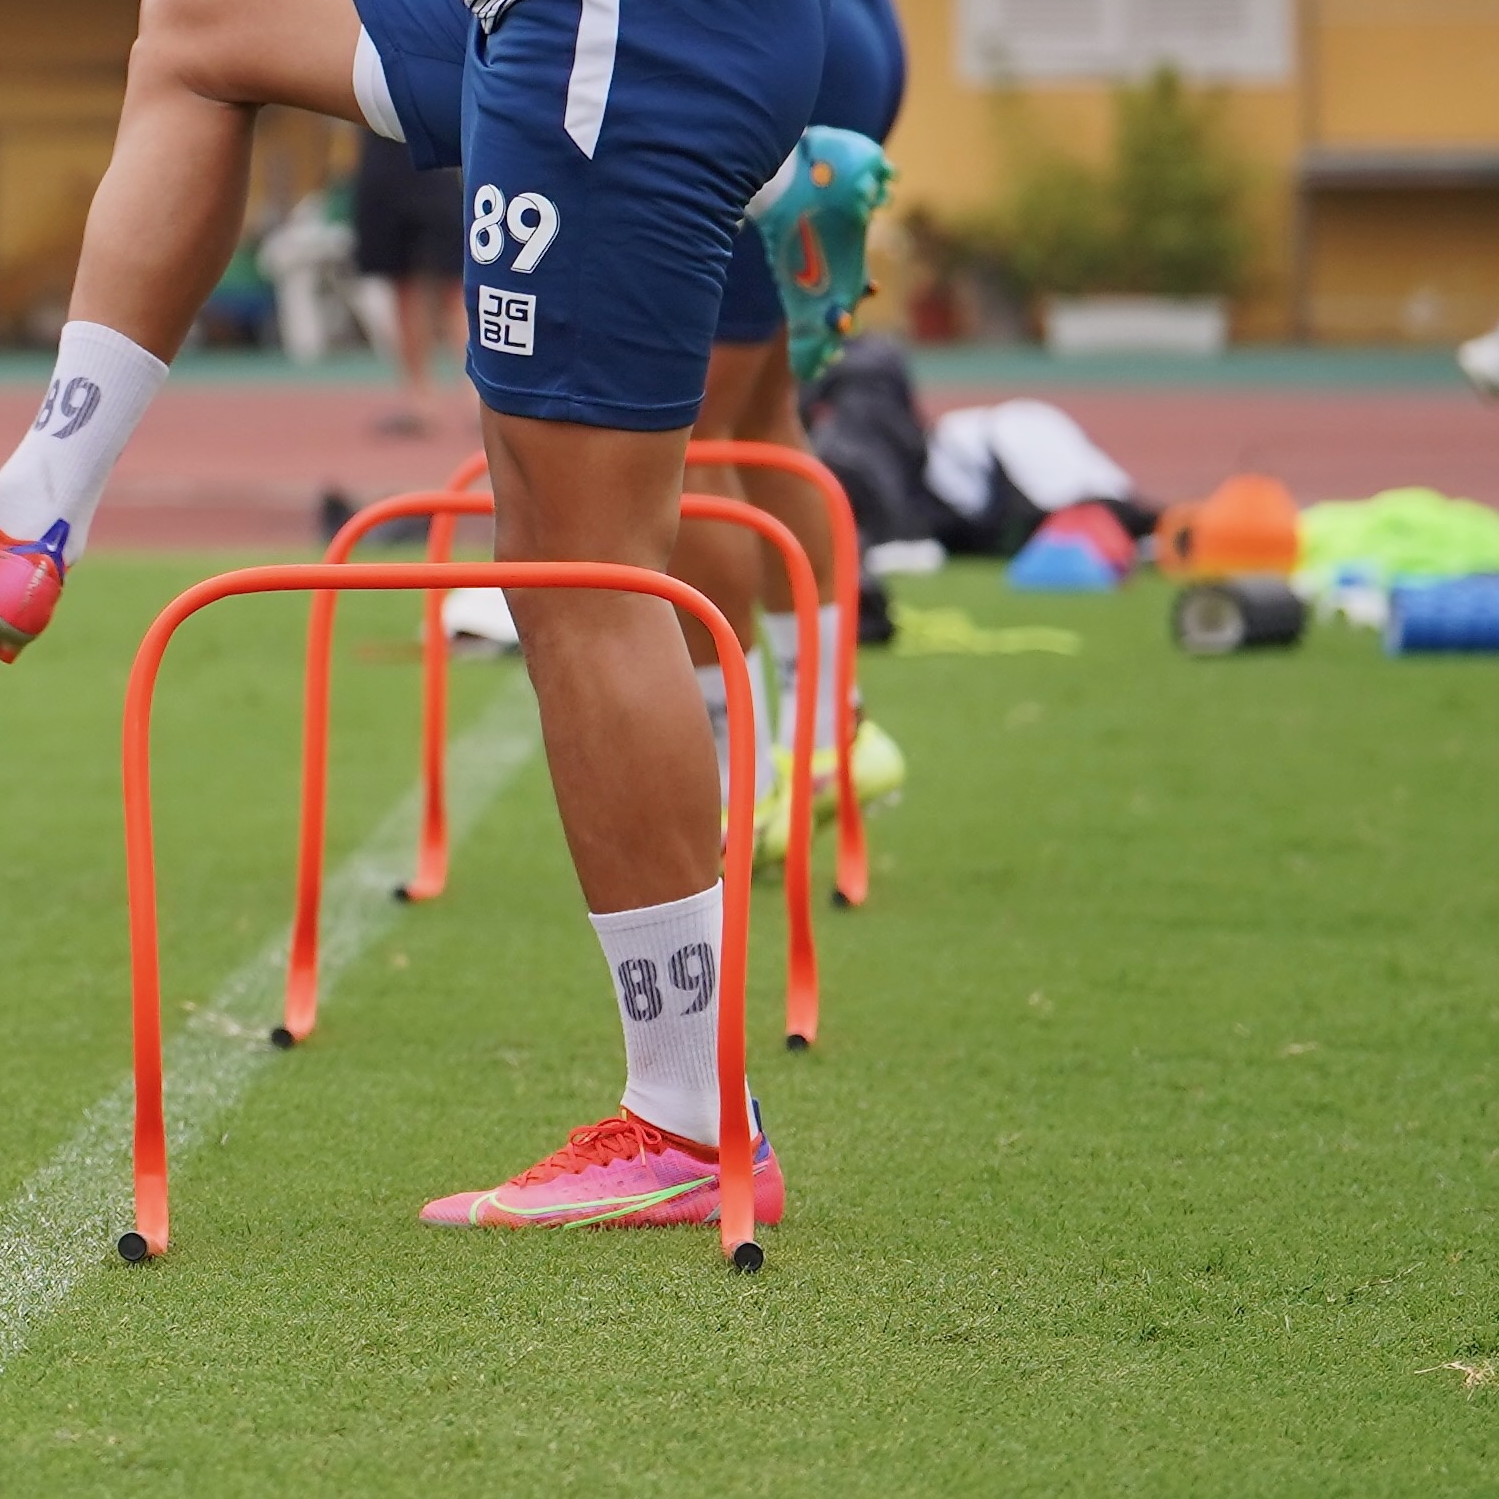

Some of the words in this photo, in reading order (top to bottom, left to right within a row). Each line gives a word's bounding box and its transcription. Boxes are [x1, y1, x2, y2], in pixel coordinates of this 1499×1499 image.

[469, 183, 561, 274] 89
[483, 294, 529, 322] JG
[484, 319, 527, 348] BL
[617, 942, 716, 1022] 89
